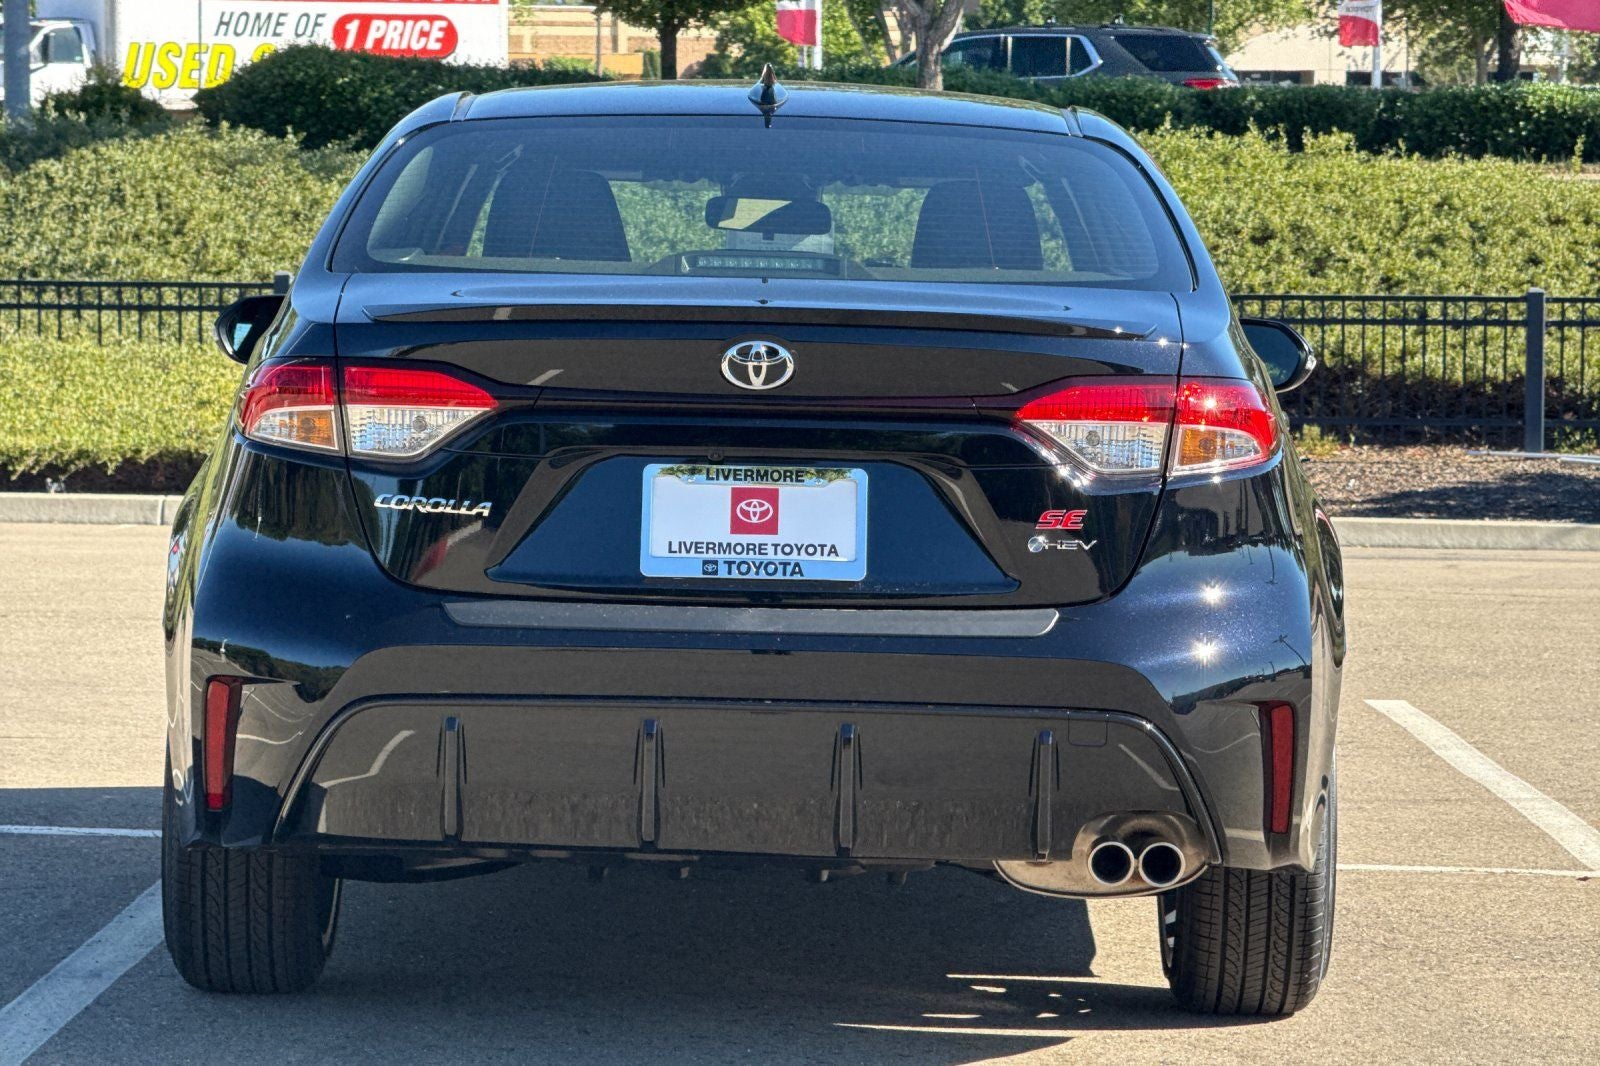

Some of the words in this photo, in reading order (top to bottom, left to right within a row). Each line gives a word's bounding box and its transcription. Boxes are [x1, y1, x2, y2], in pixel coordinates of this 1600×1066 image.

[214, 11, 288, 37] HOME
[294, 12, 327, 38] OF
[344, 19, 360, 49] 1
[364, 20, 448, 50] PRICE
[122, 42, 236, 89] USED
[705, 468, 805, 483] LIVERMORE
[374, 493, 493, 517] COROLLA
[1035, 510, 1087, 529] SE
[668, 541, 768, 556] LIVERMORE
[772, 543, 839, 557] TOYOTA
[1044, 540, 1097, 551] HEV
[724, 561, 804, 577] TOYOTA
